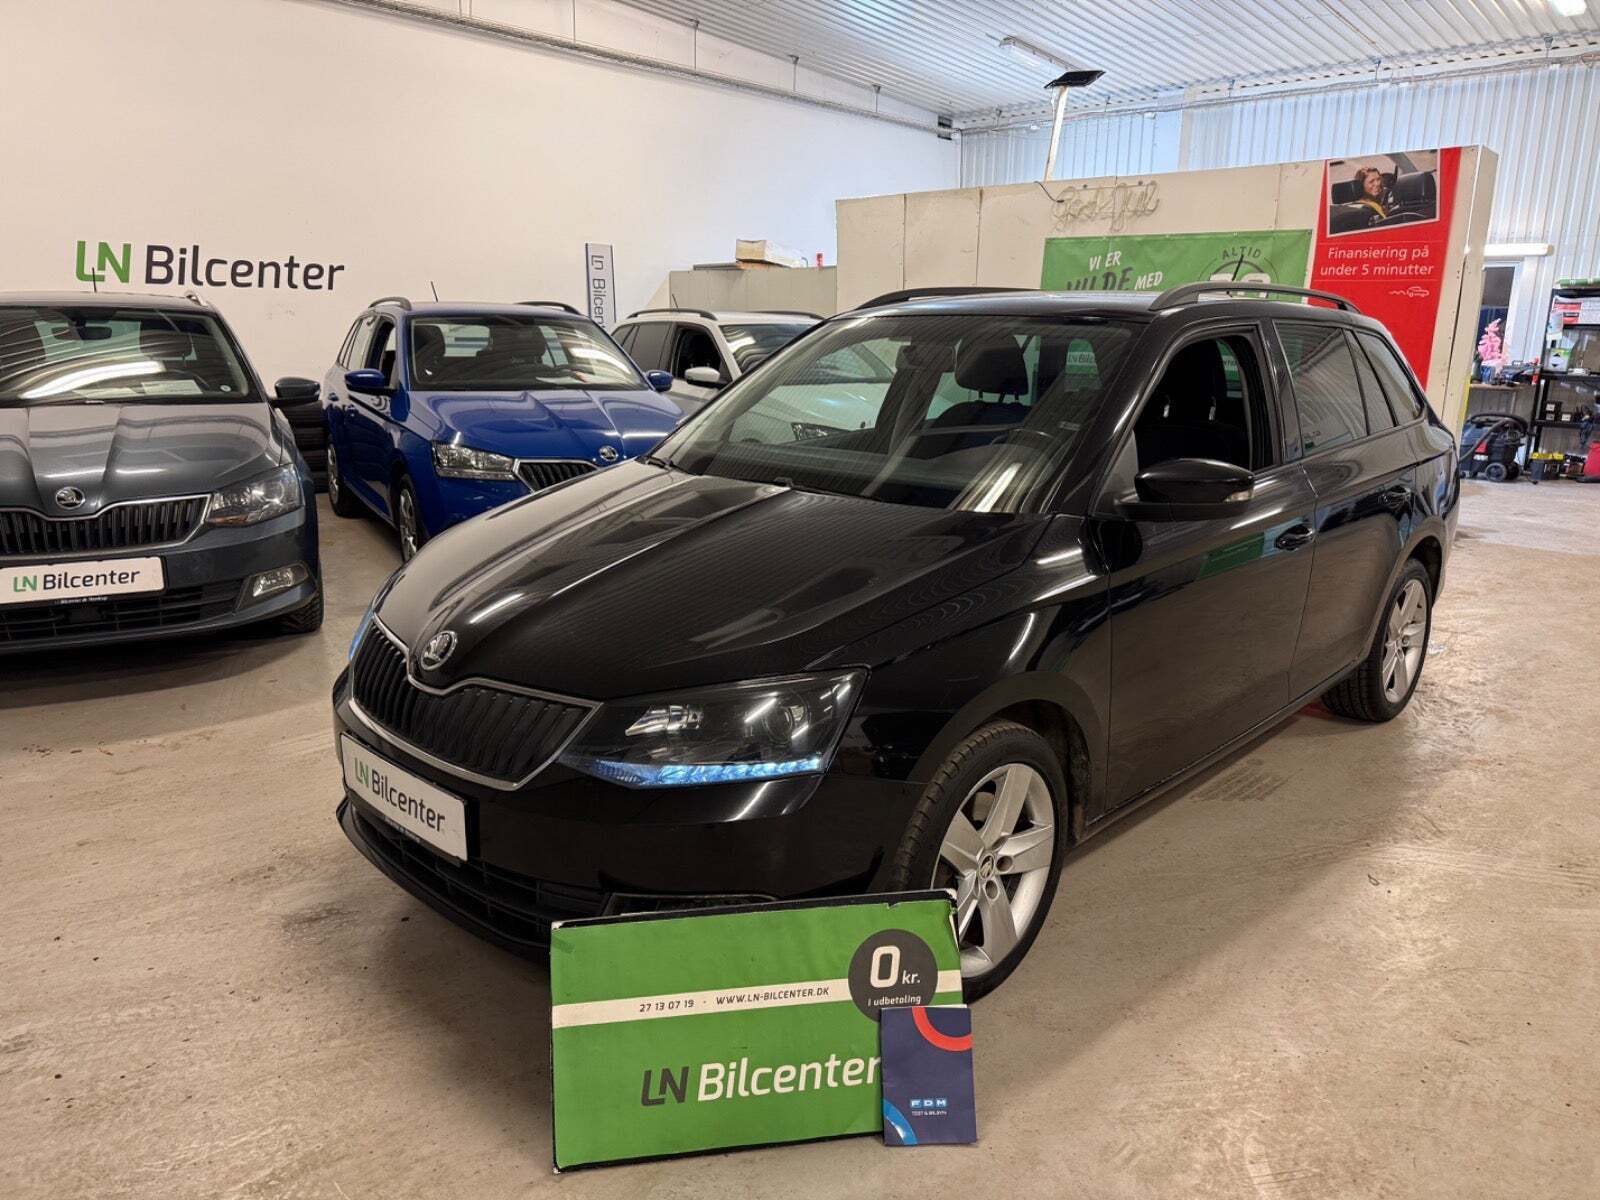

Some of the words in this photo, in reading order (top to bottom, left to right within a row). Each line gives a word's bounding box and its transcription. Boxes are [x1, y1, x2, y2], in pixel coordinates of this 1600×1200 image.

[1088, 255, 1102, 271] VI
[1105, 251, 1122, 267] ER
[1222, 246, 1262, 260] ALTID
[1328, 246, 1408, 261] Finansiering
[1411, 245, 1430, 261] på
[75, 240, 132, 283] LN
[145, 244, 345, 290] Bilcenter
[1320, 263, 1358, 276] under
[1361, 263, 1370, 276] 5
[1373, 263, 1434, 276] minutter
[1134, 271, 1163, 290] MED
[13, 575, 38, 593] LN
[43, 570, 141, 591] Bilcenter
[354, 757, 369, 788] LN
[371, 768, 446, 832] Bilcenter
[869, 944, 901, 988] 0
[902, 970, 921, 986] kr.
[639, 1003, 652, 1013] 27
[655, 1002, 665, 1011] 13
[668, 1000, 680, 1010] 07
[684, 999, 695, 1008] 19
[716, 987, 830, 1006] WWW.LN-BILCENTER.DK
[873, 994, 922, 1007] udbetaling
[640, 1066, 690, 1106] LN
[698, 1053, 881, 1102] Bilcenter
[911, 1098, 947, 1108] FDM
